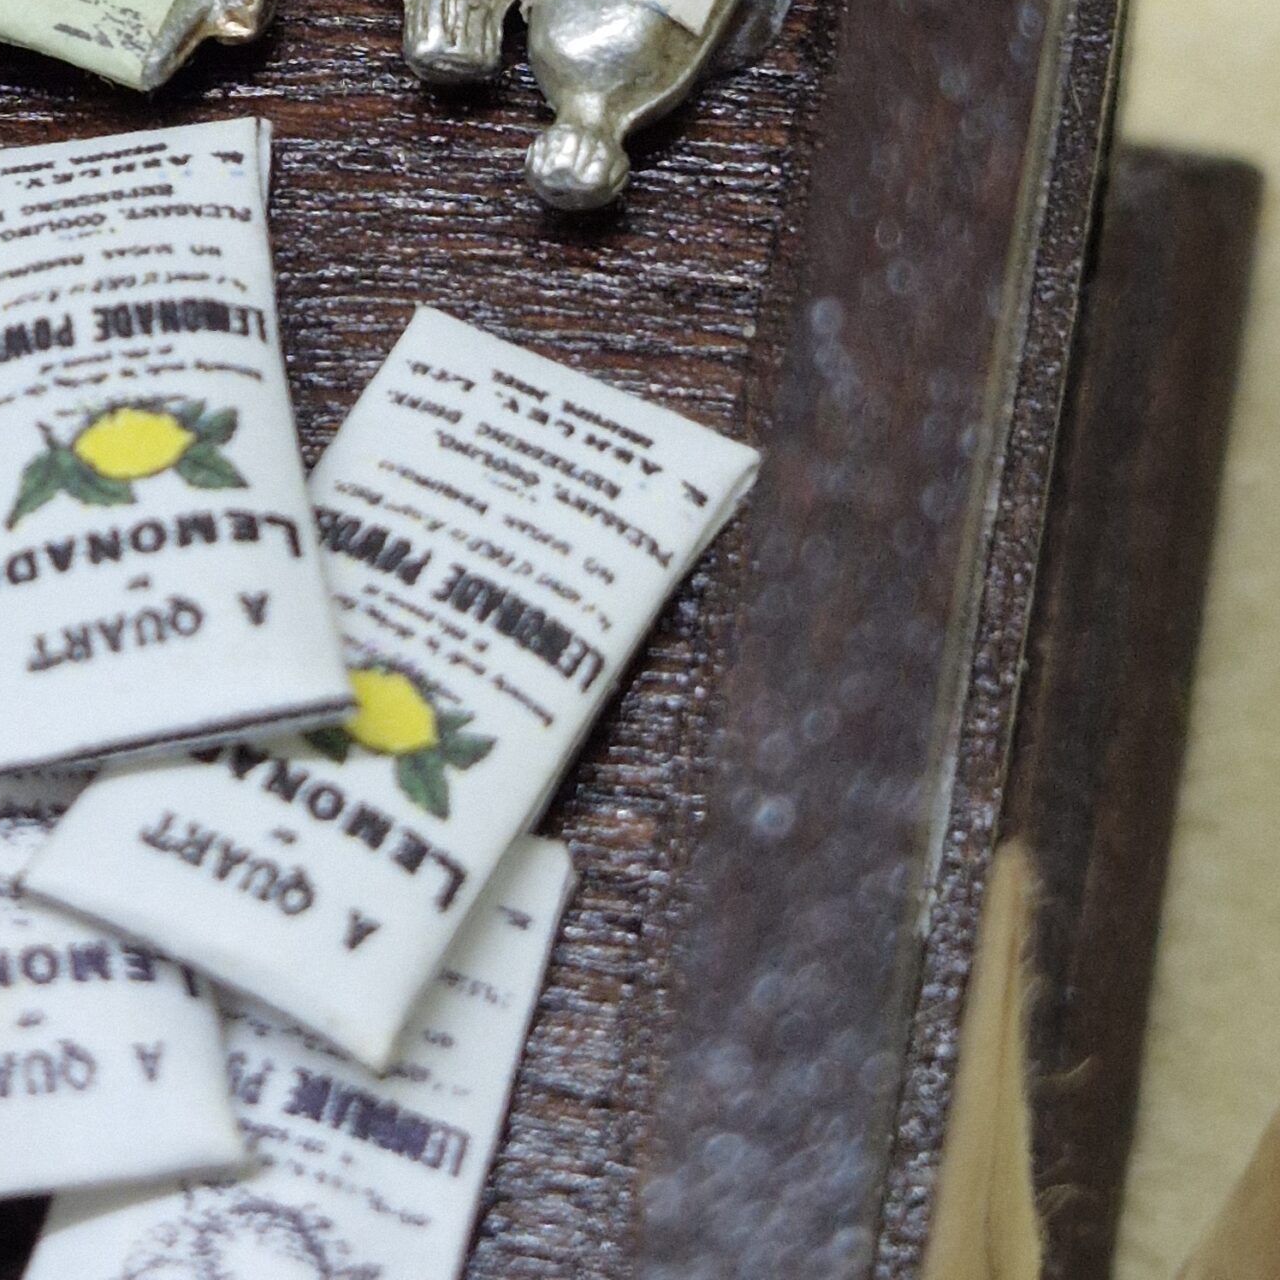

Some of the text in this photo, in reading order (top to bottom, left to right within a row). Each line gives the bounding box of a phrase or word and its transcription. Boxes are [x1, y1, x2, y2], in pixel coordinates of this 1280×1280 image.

[93, 298, 267, 345] LEMONADE
[25, 592, 268, 671] A QUART
[435, 568, 608, 693] LEMONADE
[140, 811, 379, 950] A QUART
[135, 1043, 161, 1082] A
